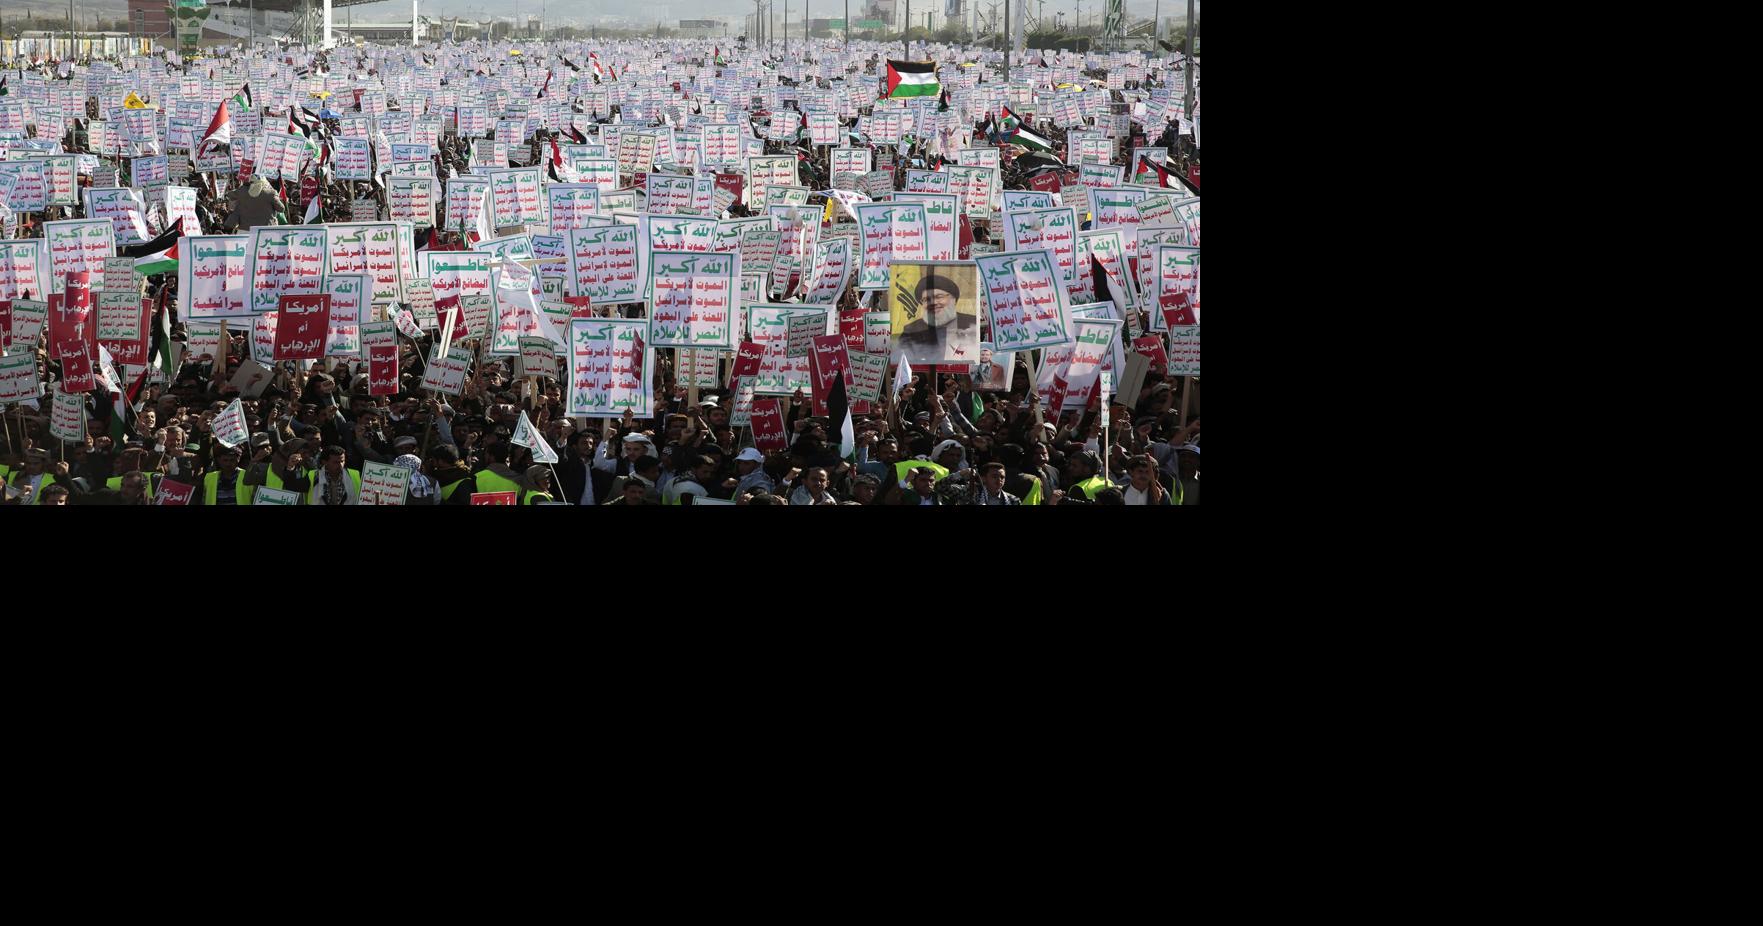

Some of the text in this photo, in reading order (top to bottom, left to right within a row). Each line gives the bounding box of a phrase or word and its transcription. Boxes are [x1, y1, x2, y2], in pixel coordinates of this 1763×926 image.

[898, 210, 921, 222] الله
[1049, 214, 1070, 226] الله
[88, 226, 108, 238] الله
[372, 229, 394, 242] الله
[612, 232, 633, 242] الله
[692, 225, 714, 237] الله
[85, 241, 109, 250] الموت
[260, 232, 323, 249] الله أكبر
[15, 246, 34, 258] الله
[294, 251, 322, 262] الموت
[369, 248, 394, 256] الموت
[608, 246, 634, 256] الموت
[370, 261, 395, 270] الموت
[432, 258, 488, 274] قاطعوا
[610, 260, 634, 268] الموت
[656, 256, 728, 275] الله أكبر
[987, 258, 1048, 280] الله أكبر
[293, 266, 320, 275] الموت
[335, 278, 358, 293] الله
[462, 278, 488, 290] البضائع
[696, 280, 727, 290] الموت
[1020, 278, 1050, 289] الموت
[372, 288, 398, 300] النصر
[613, 284, 637, 296] النصر
[696, 297, 726, 306] الموت
[1024, 294, 1055, 305] الموت
[286, 298, 324, 315] أمريكا
[654, 312, 725, 323] اللعنة على اليهود
[298, 321, 308, 334] أم
[1034, 324, 1062, 338] النصر
[577, 324, 616, 344] أكبر
[694, 326, 725, 342] النصر
[574, 380, 599, 392] اليهود
[602, 380, 616, 391] على
[610, 395, 642, 410] النصر
